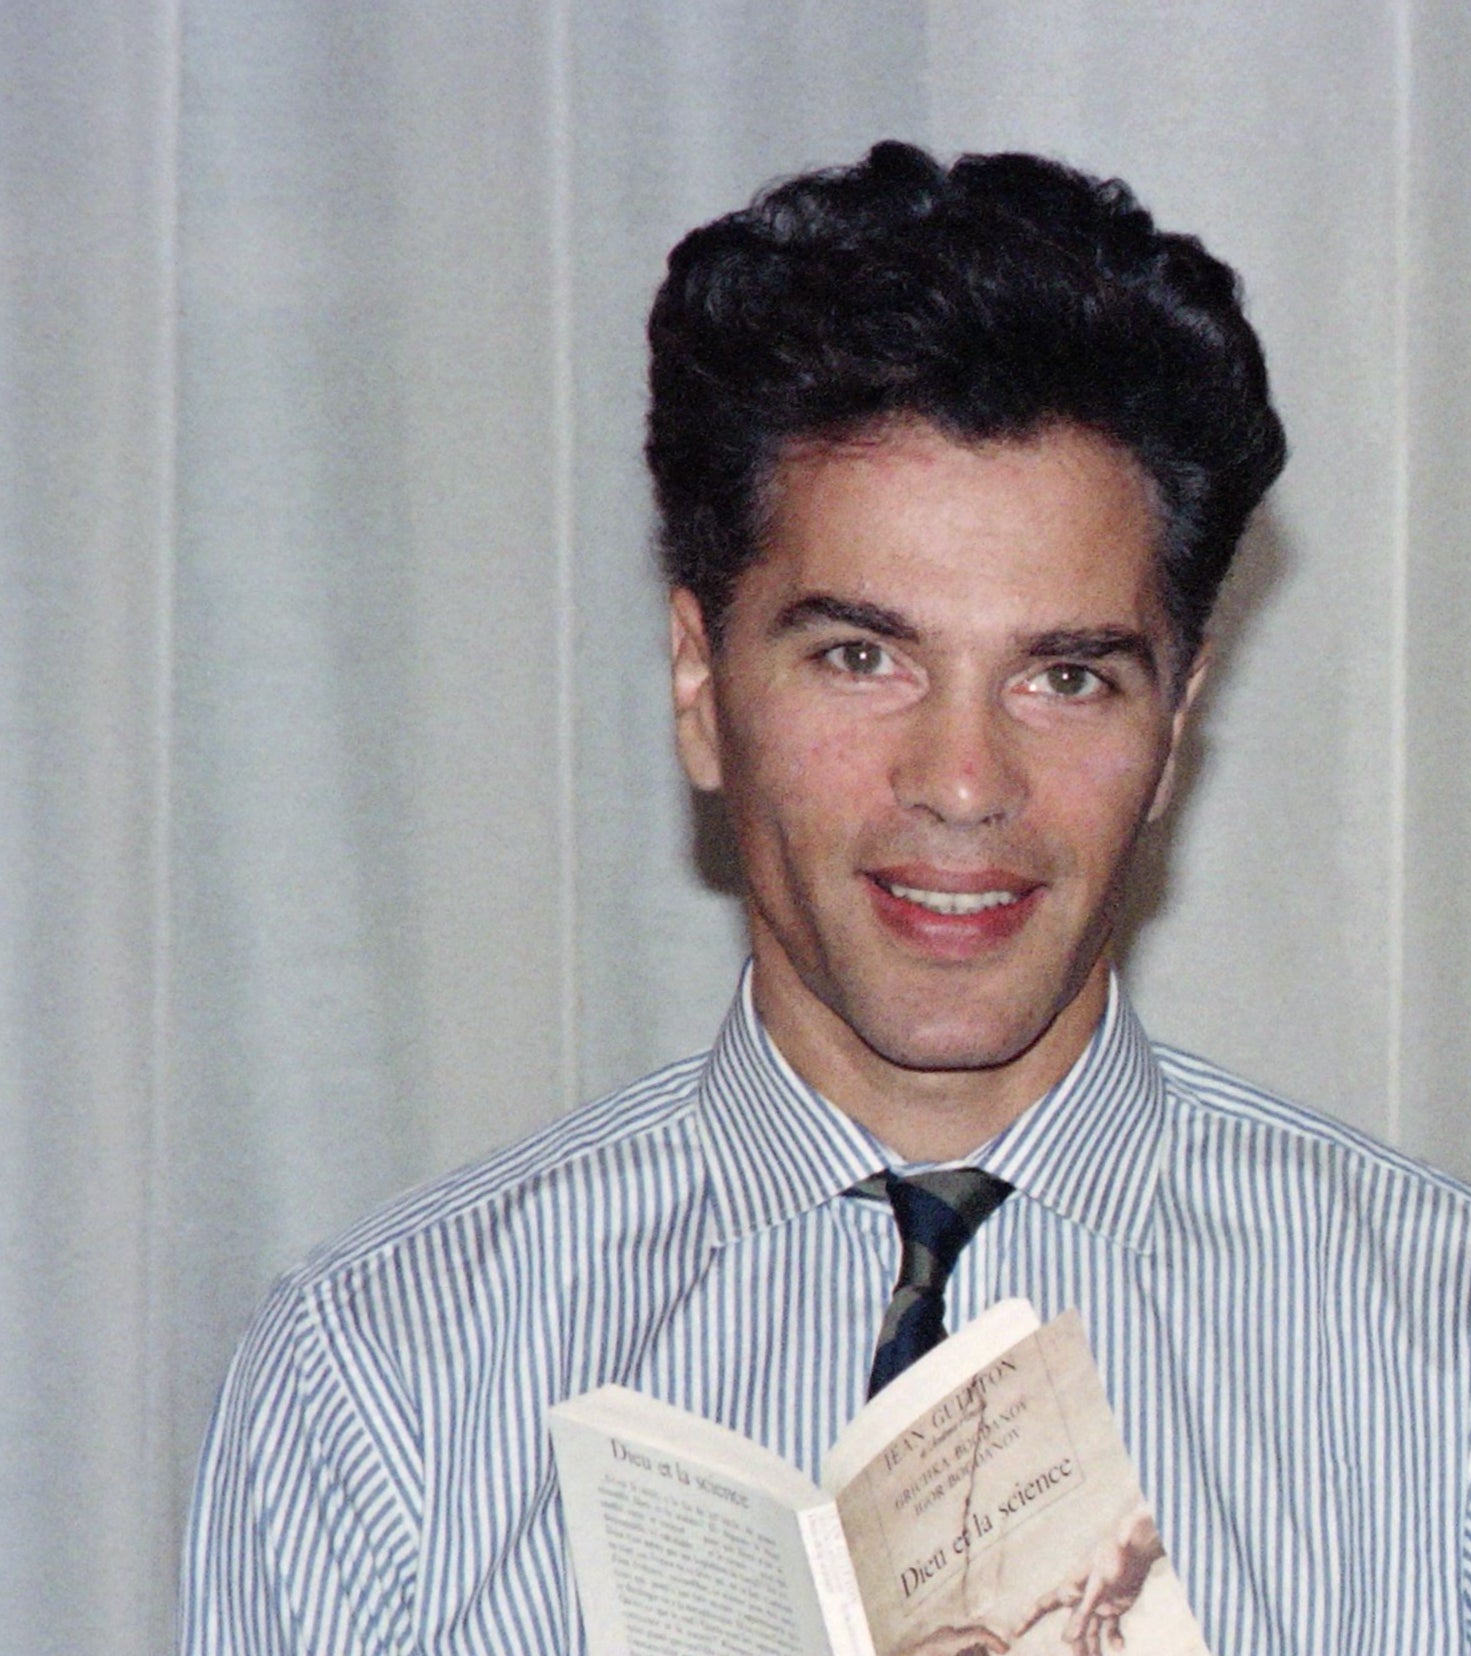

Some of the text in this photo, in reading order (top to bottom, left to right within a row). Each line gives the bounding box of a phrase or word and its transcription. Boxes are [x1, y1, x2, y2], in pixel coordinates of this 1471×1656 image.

[610, 1436, 750, 1510] Dieu et la science
[882, 1428, 927, 1473] JEAN
[898, 1456, 1074, 1600] Dieu et la science
